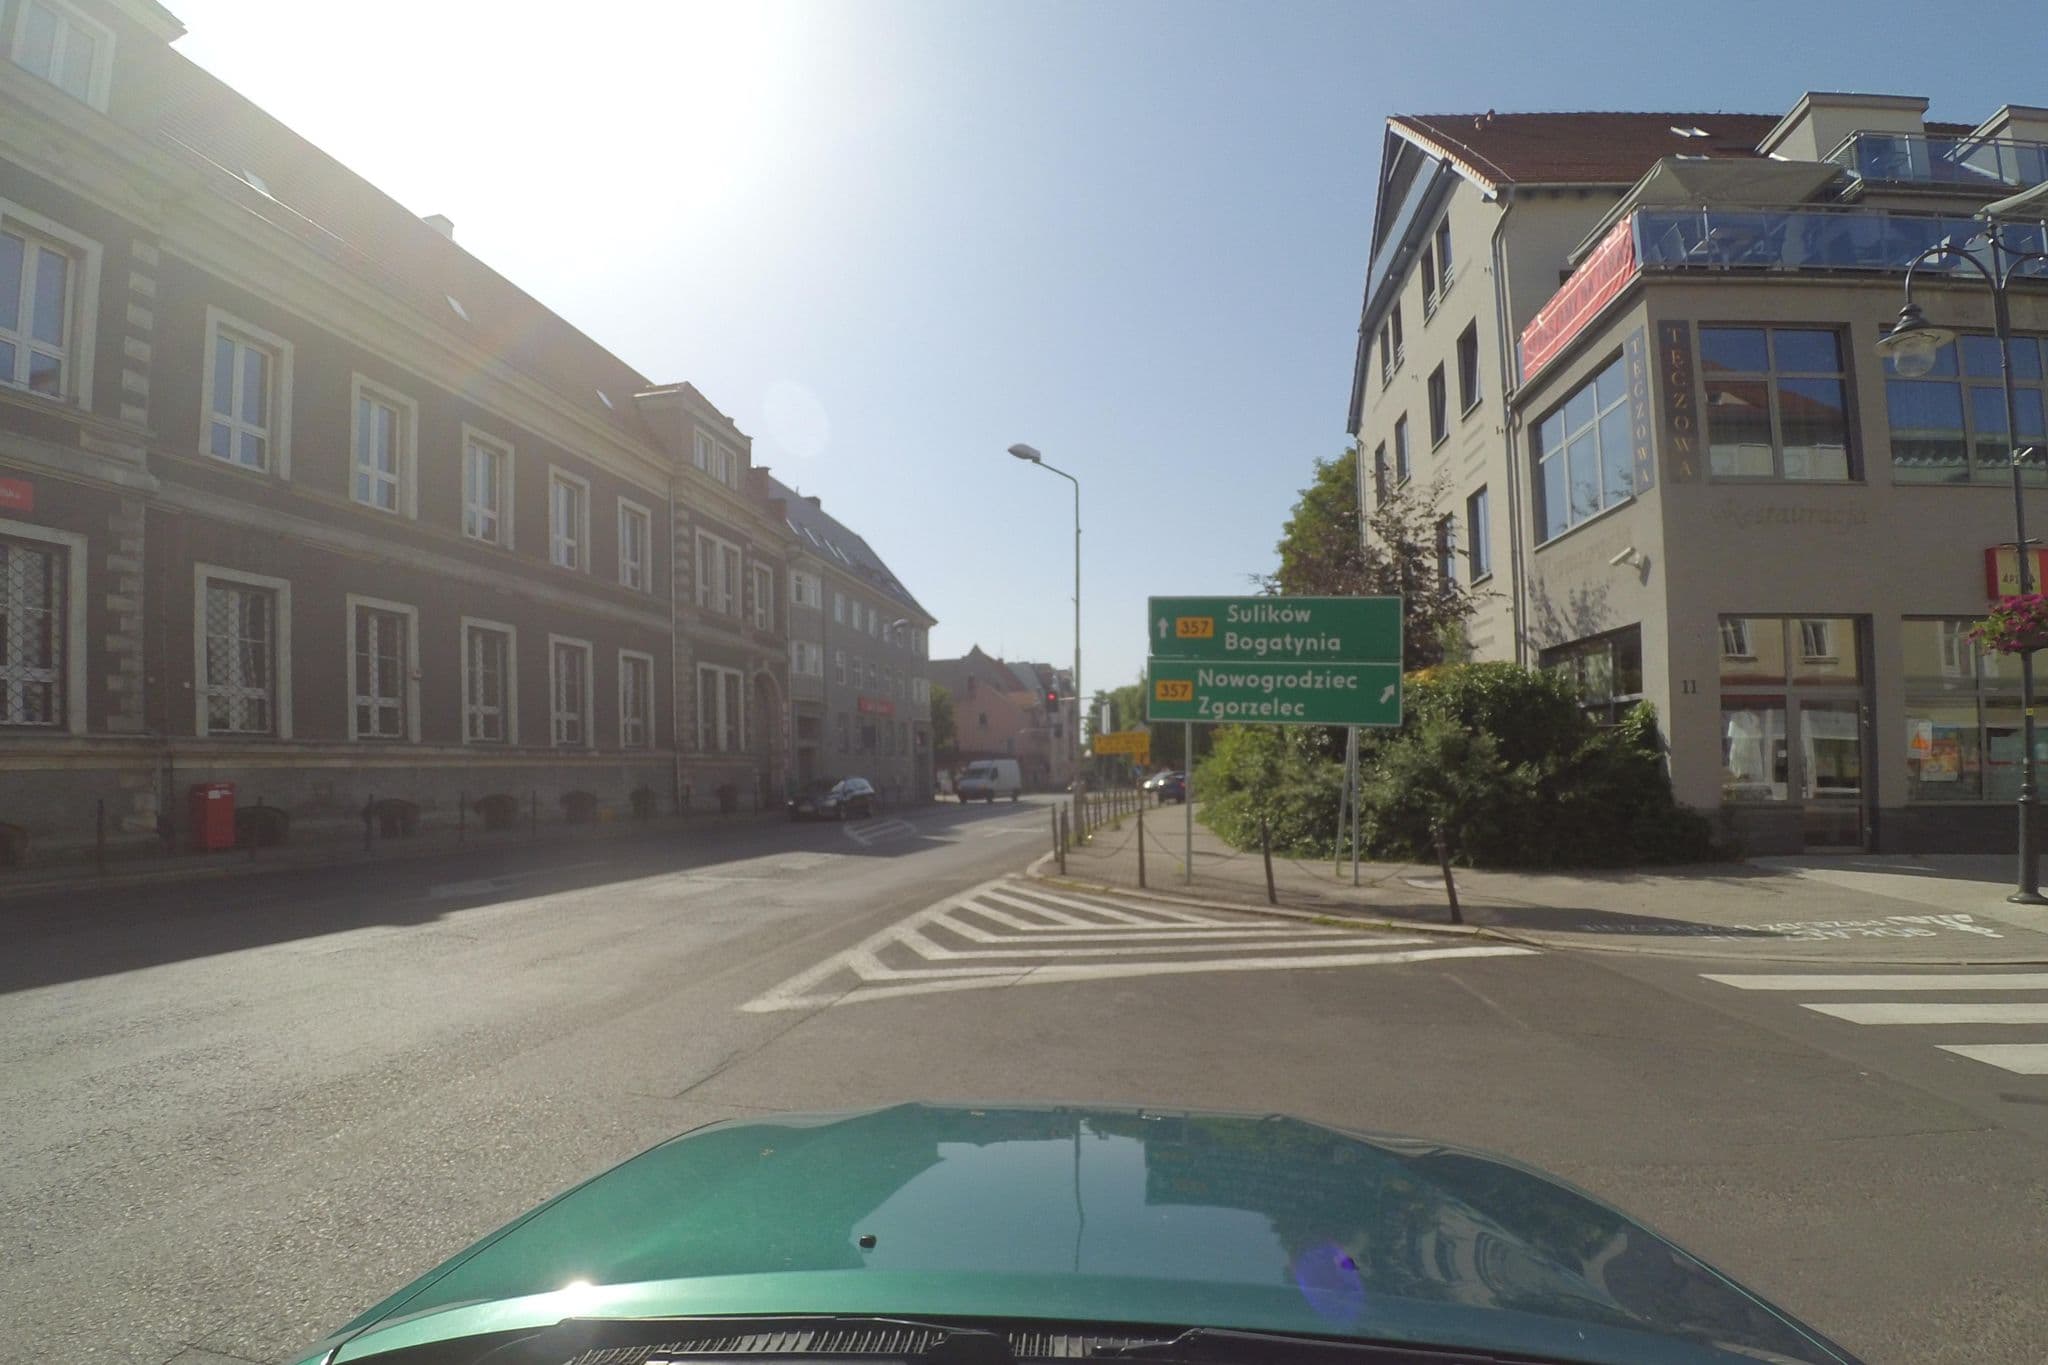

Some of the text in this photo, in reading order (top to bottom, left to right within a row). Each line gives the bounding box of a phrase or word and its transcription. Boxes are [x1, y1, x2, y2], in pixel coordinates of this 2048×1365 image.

[1226, 603, 1311, 623] Sulików
[1180, 620, 1209, 634] 357
[1224, 632, 1341, 656] Bogatynia
[1160, 684, 1189, 698] 357
[1197, 669, 1358, 693] Nowogrodziec
[1198, 696, 1305, 720] Zgorzelec
